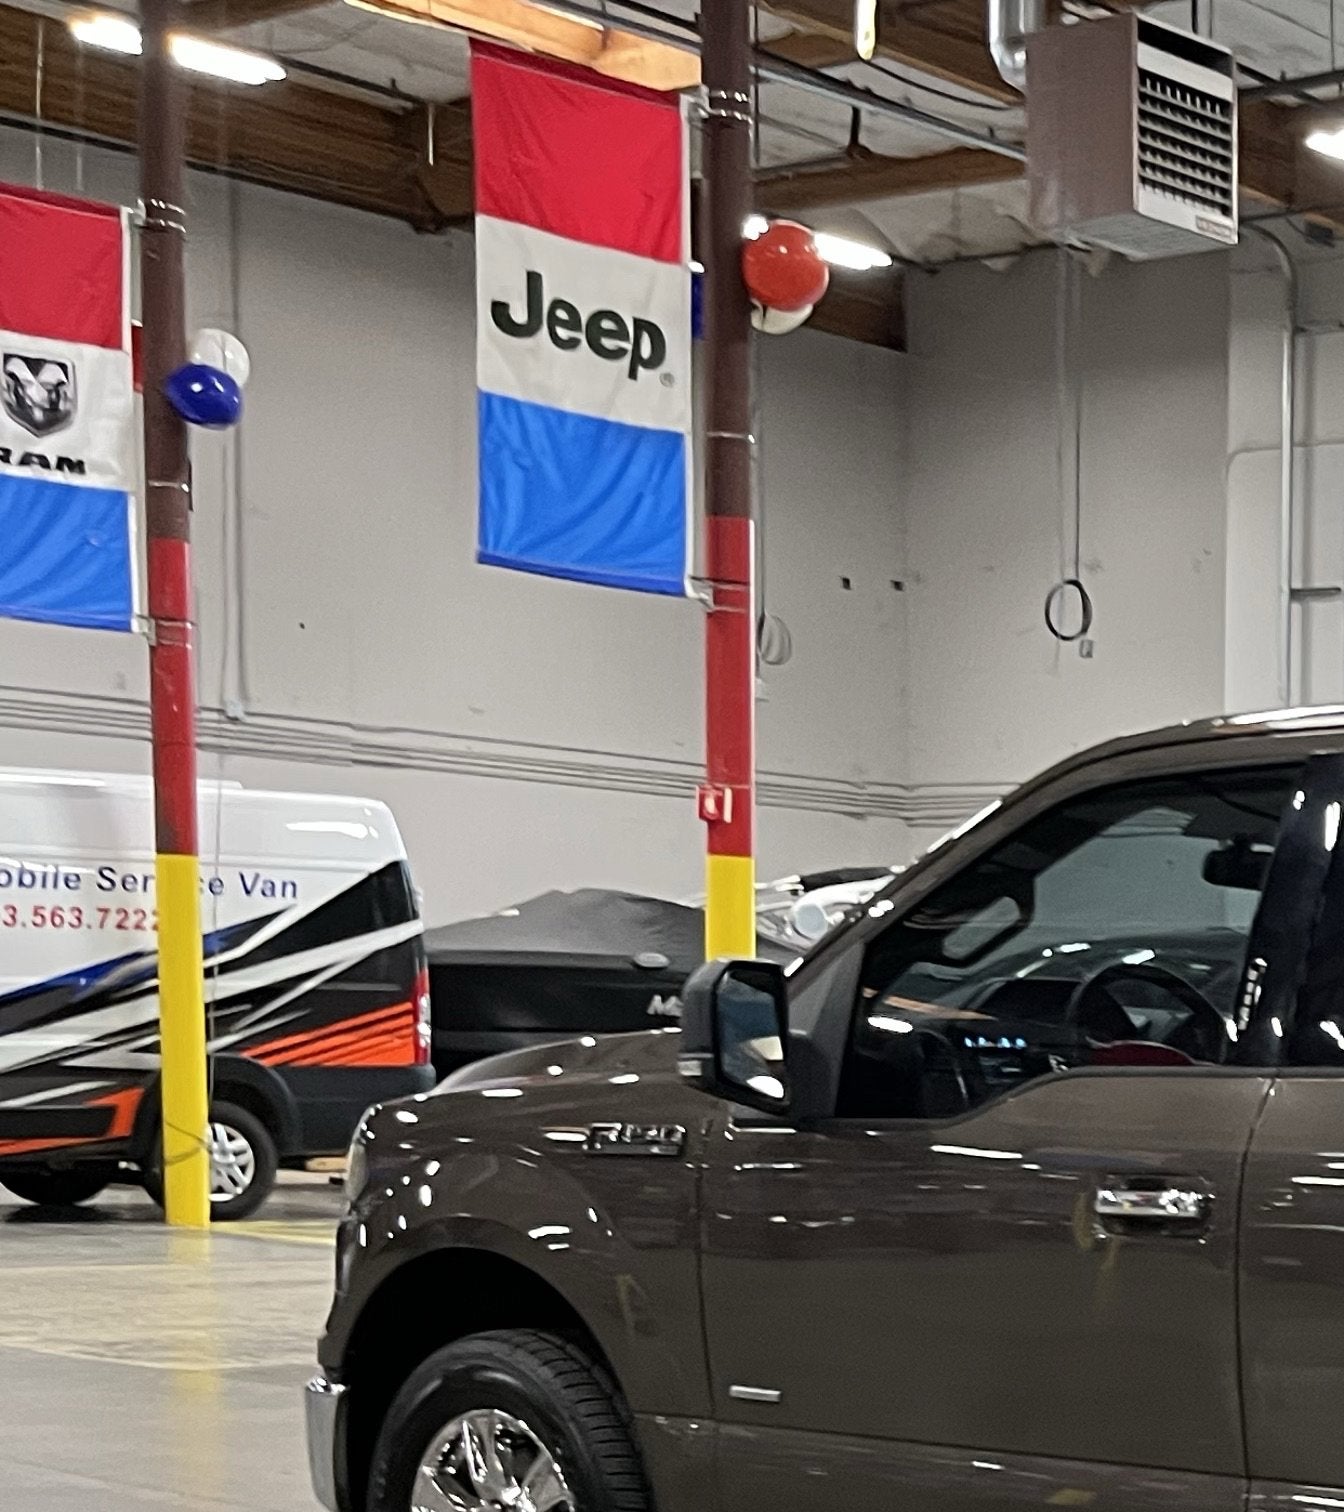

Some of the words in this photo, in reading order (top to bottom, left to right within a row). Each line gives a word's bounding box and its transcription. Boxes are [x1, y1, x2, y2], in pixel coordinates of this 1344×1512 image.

[491, 269, 667, 381] Jeep
[0, 861, 81, 891] obile
[96, 866, 225, 897] Sere
[238, 871, 298, 898] Van
[2, 904, 160, 932] 3.563.722
